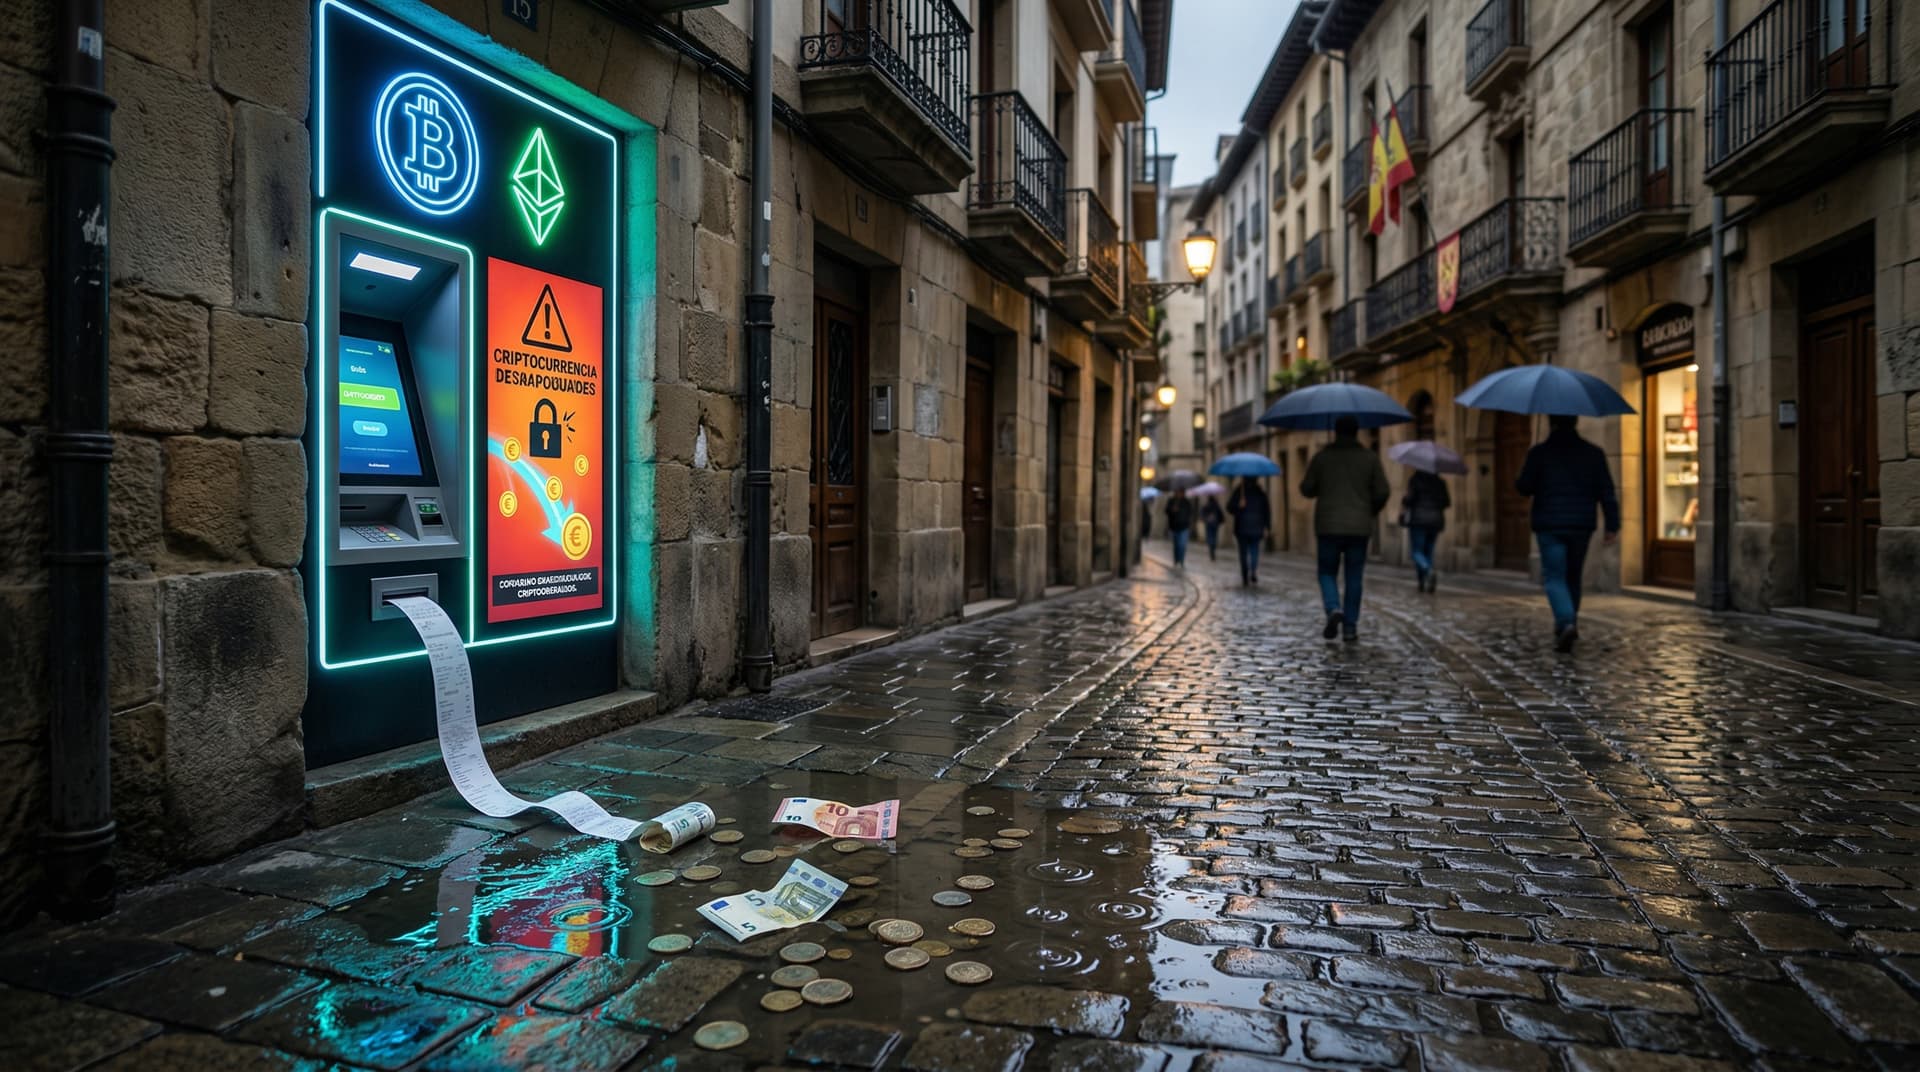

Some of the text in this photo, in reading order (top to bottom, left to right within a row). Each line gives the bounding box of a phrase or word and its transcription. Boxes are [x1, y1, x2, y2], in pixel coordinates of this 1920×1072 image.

[493, 348, 598, 379] CRIPTOCURRENCIA
[826, 803, 849, 817] 10
[744, 893, 767, 907] 5
[741, 921, 758, 932] 5
